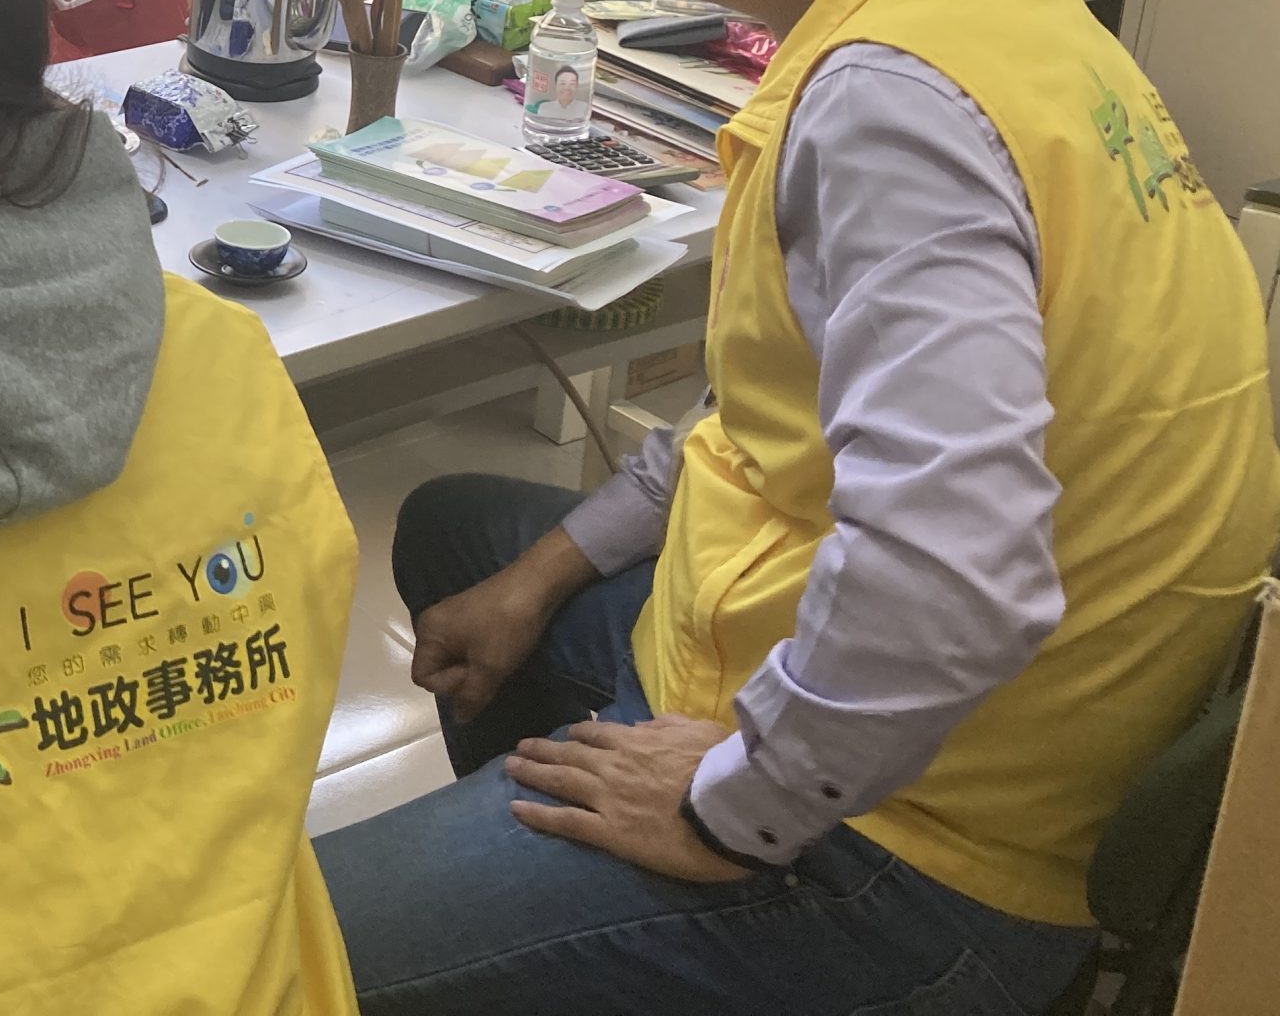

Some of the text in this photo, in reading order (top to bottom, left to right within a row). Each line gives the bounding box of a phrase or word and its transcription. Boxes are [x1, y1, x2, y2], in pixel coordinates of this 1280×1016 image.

[19, 534, 266, 652] I SEE YOU
[31, 623, 292, 752] 地政事務所
[124, 729, 158, 753] Land
[269, 686, 297, 706] City
